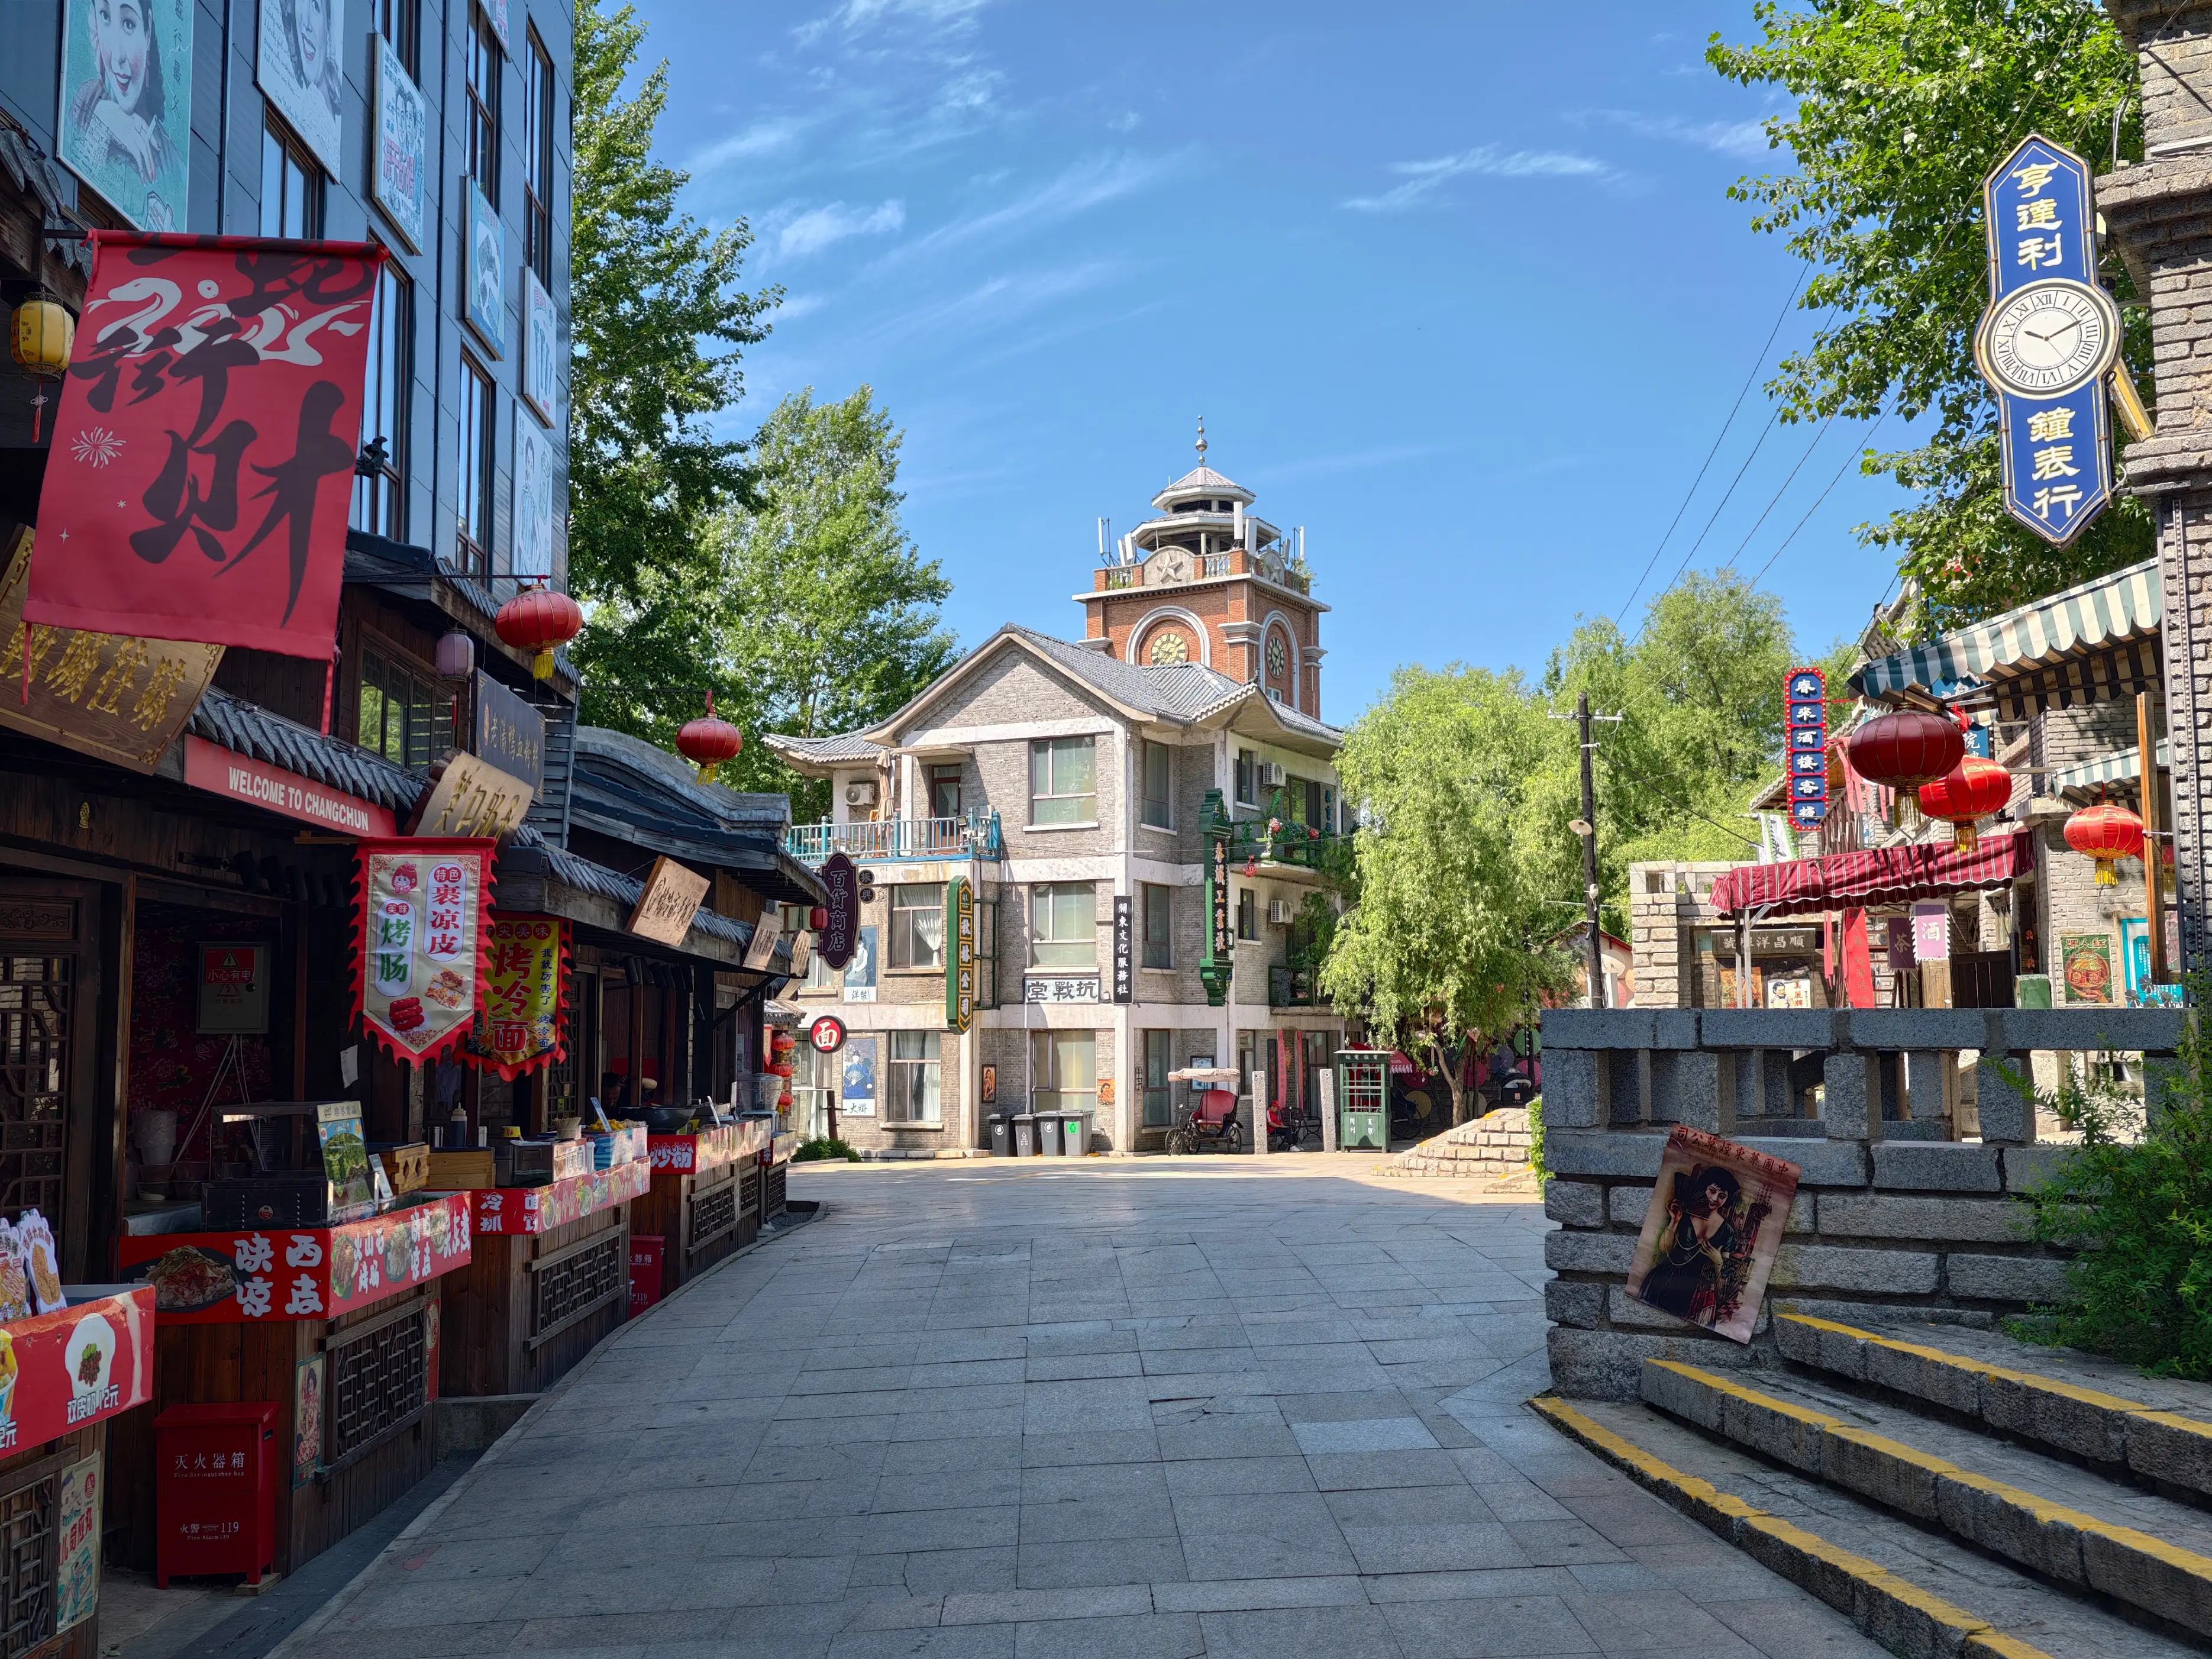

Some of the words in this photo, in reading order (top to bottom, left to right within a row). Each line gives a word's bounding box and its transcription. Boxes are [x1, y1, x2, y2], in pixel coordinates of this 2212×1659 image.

[2013, 160, 2063, 270] 亨達利
[228, 766, 286, 806] WELCOME
[288, 786, 302, 811] TO
[305, 792, 369, 832] CHANGCHUN
[435, 868, 460, 882] 特色
[860, 872, 872, 900] 振興
[386, 903, 408, 915] 美味
[427, 884, 461, 955] 裹凉皮
[827, 870, 848, 952] 百貨商店
[1895, 932, 1911, 953] 茶
[1922, 921, 1941, 941] 酒
[378, 918, 412, 982] 烤肠
[961, 918, 972, 1016] 秋林公司
[208, 970, 251, 981] 小心有电
[539, 948, 553, 1006] 我就厉害了
[490, 942, 535, 1053] 烤冷面
[537, 1014, 551, 1048] 烤冷面
[815, 1021, 838, 1048] 面
[233, 1232, 323, 1273] 陕西
[234, 1273, 324, 1318] 凉皮
[175, 1451, 246, 1470] 灭火器箱
[179, 1523, 201, 1534] 火警
[221, 1521, 240, 1533] 119
